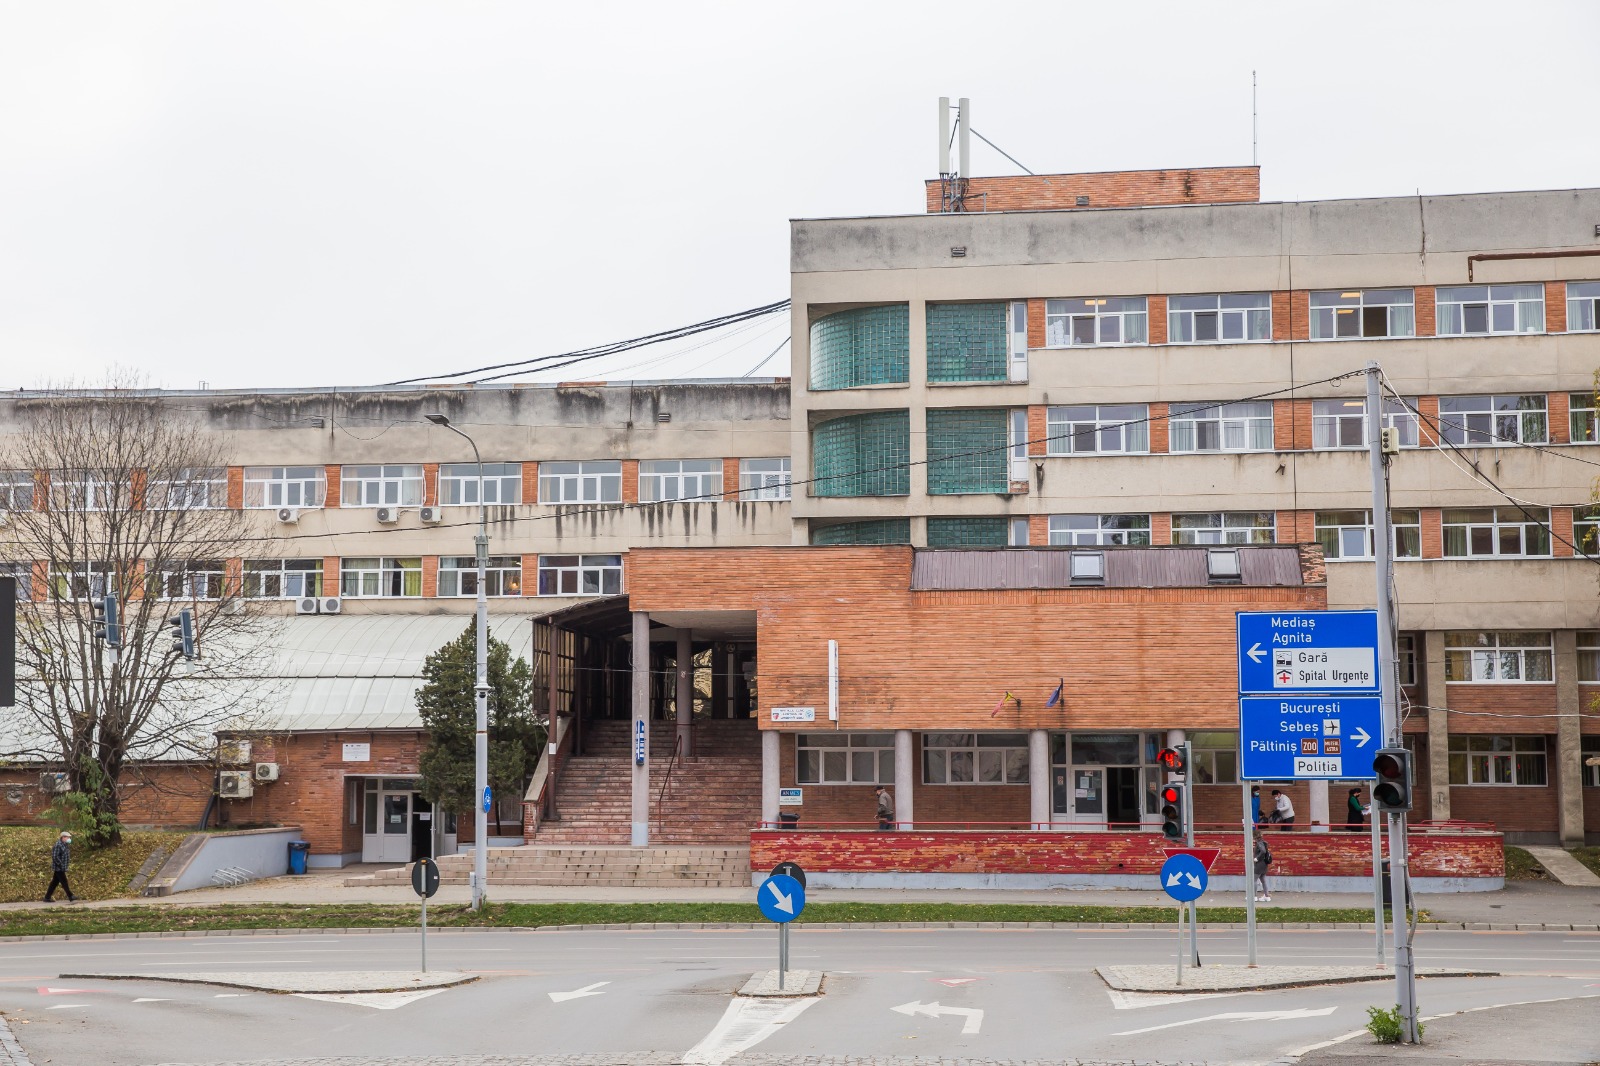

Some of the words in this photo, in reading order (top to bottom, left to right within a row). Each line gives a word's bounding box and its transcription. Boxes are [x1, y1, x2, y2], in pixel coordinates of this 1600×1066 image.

[1271, 617, 1316, 631] Mediaș
[1272, 632, 1312, 645] Agnita
[1298, 652, 1328, 663] Gară
[1299, 670, 1327, 683] Spital
[1332, 670, 1369, 684] Urgențe
[1280, 702, 1341, 717] București
[1280, 721, 1319, 736] Sebeș
[1250, 740, 1297, 755] Păltiniș
[1303, 741, 1317, 751] ZOO
[1298, 761, 1338, 775] Poliția
